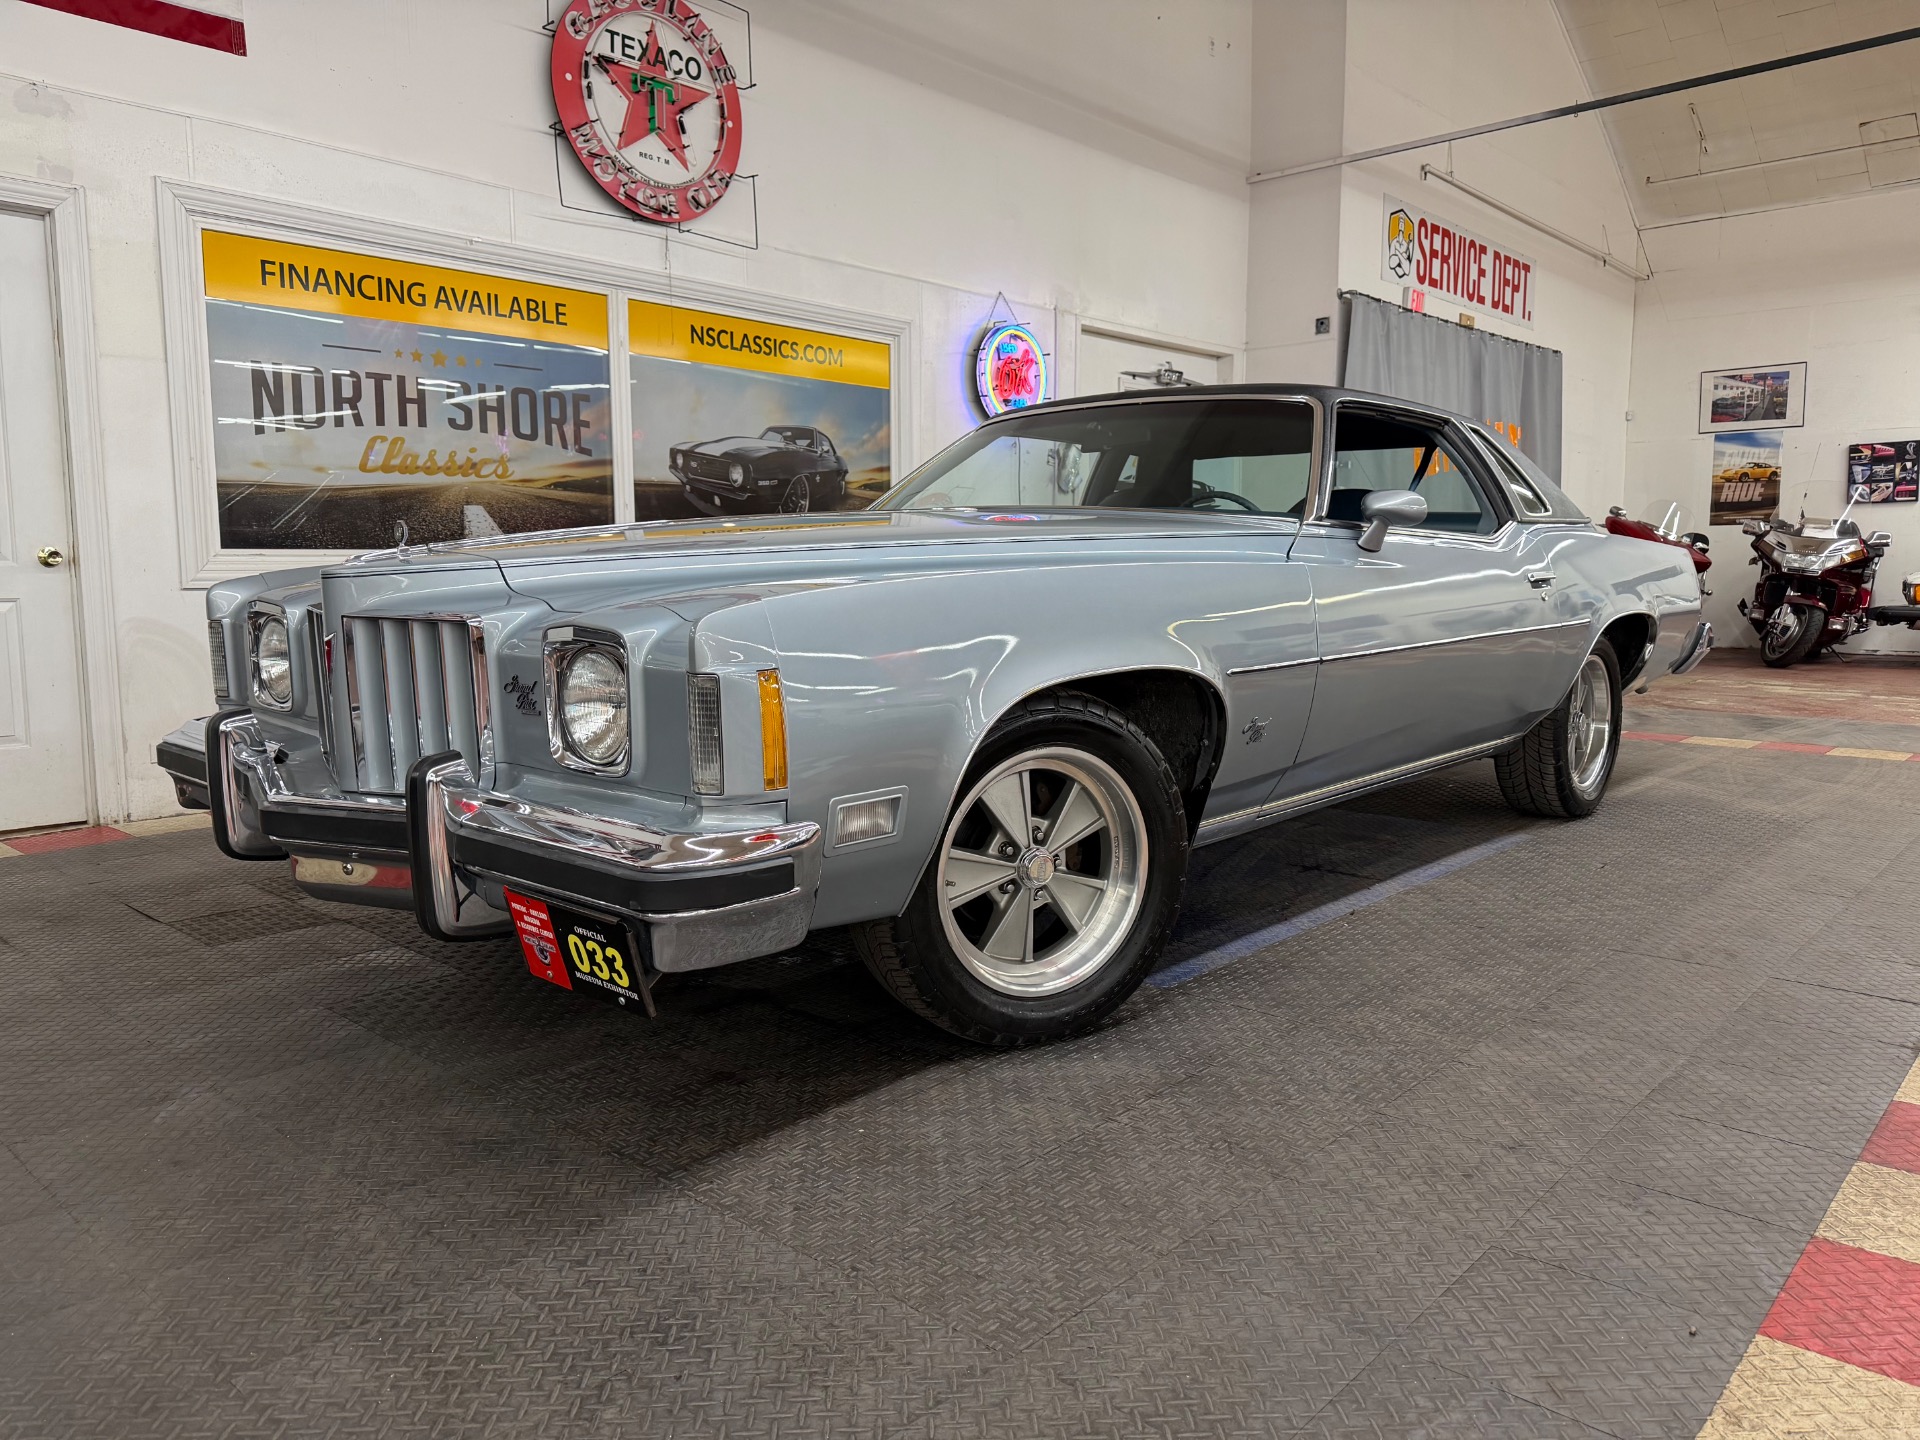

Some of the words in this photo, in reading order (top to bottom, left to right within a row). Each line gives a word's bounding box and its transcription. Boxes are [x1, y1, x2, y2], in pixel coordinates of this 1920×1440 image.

[604, 28, 701, 80] TEXACO
[570, 121, 681, 219] MOTOR
[685, 168, 735, 213] OIL
[259, 259, 427, 309] FINANCING
[433, 285, 568, 326] AVAILABLE
[1416, 217, 1488, 306] SERVICE
[1490, 249, 1532, 322] DEPT.
[690, 324, 843, 367] NSCLASSICS.COM
[999, 349, 1034, 399] OK
[250, 360, 428, 436] NORTH
[447, 379, 593, 458] SHORE
[358, 434, 515, 480] Classics
[1720, 481, 1766, 503] RIDE
[574, 925, 607, 943] OFFICIAL
[567, 933, 630, 988] 033
